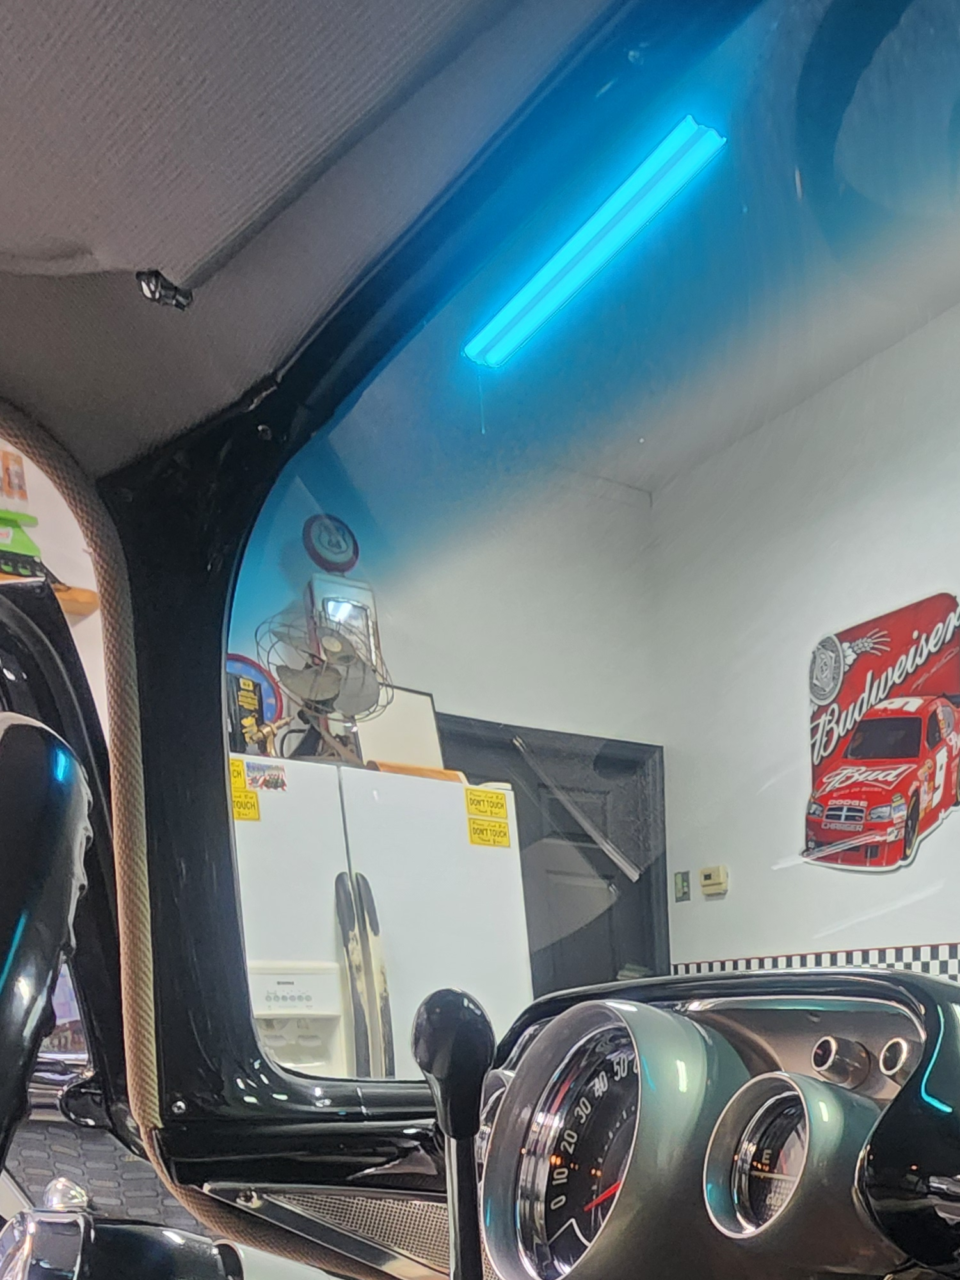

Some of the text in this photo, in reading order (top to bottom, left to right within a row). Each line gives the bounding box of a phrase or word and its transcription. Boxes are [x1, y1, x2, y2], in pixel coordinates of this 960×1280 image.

[823, 765, 905, 793] Bud
[931, 745, 948, 809] 9
[827, 799, 868, 807] DODGE
[612, 1055, 628, 1082] 50
[592, 1070, 609, 1099] 40
[574, 1096, 592, 1124] 30
[560, 1130, 578, 1154] 20
[762, 1149, 773, 1164] E
[552, 1167, 569, 1186] 10
[550, 1194, 567, 1211] 0
